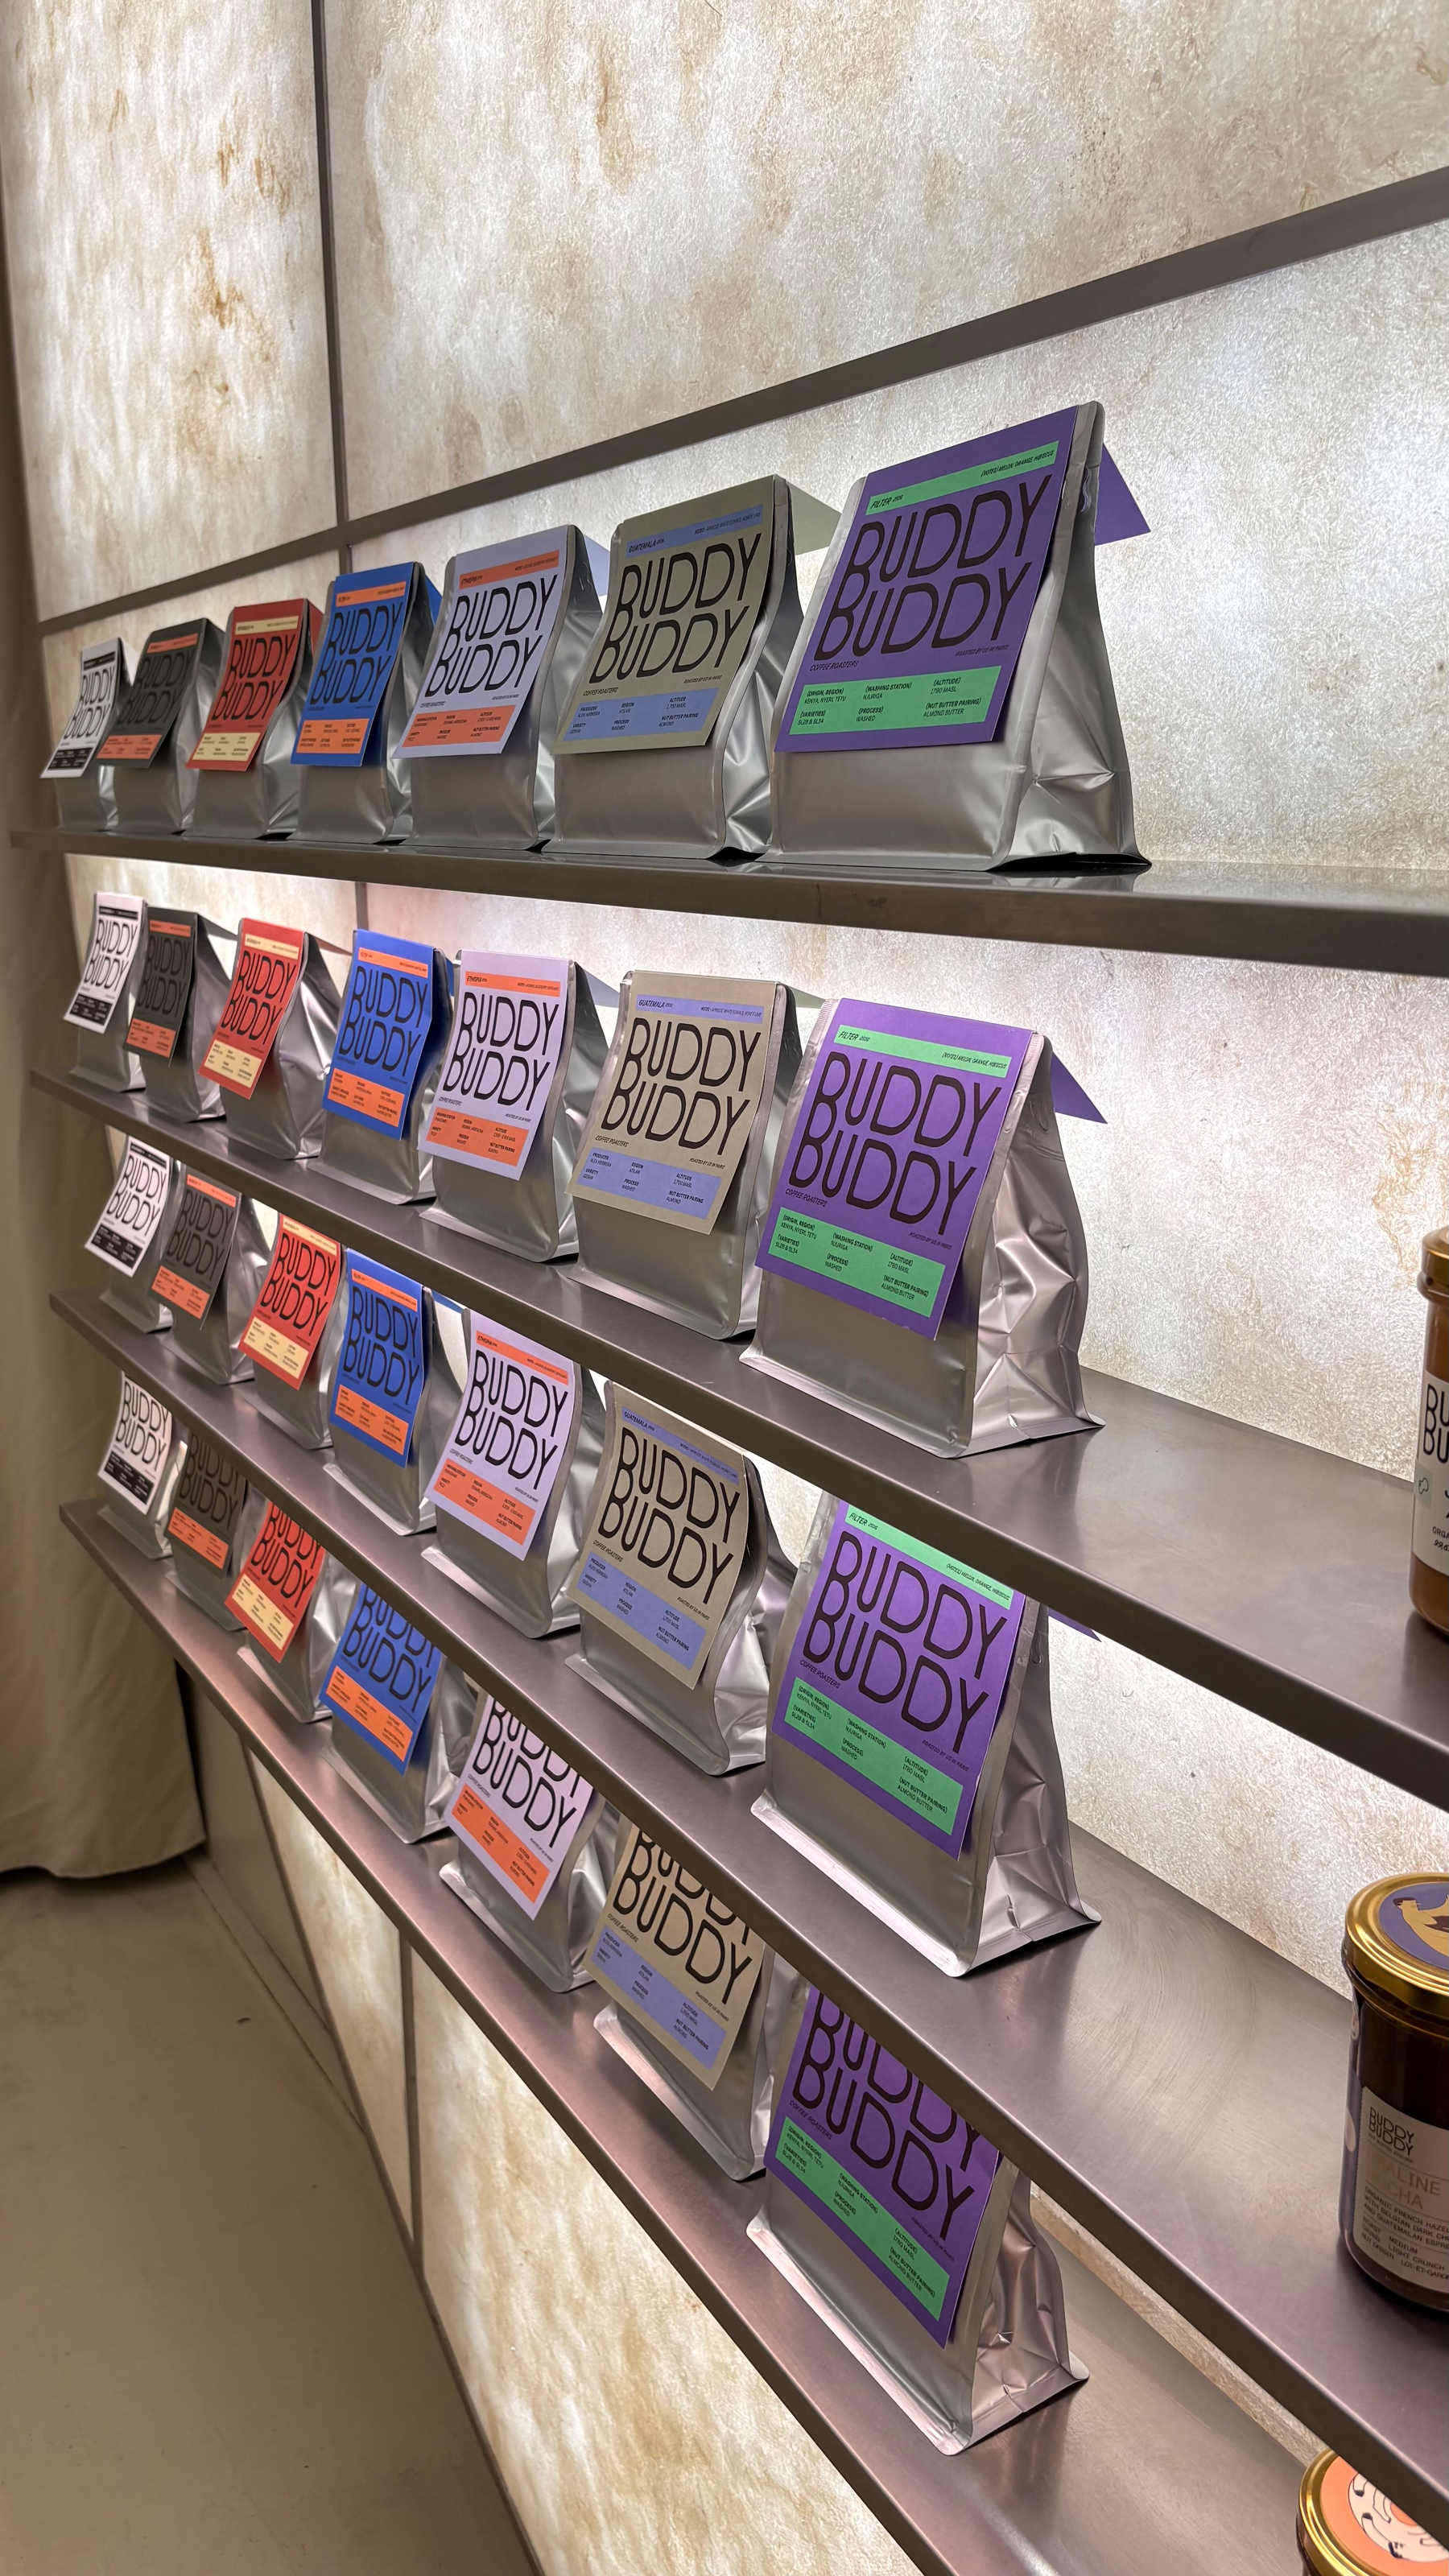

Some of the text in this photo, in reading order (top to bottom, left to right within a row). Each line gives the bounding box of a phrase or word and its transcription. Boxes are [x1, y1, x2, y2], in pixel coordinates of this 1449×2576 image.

[870, 497, 892, 509] FILTER
[840, 474, 1052, 585] BUDDY
[613, 533, 762, 619] BUDDY
[324, 602, 403, 654] BUDDY
[445, 575, 558, 642] BUDDY
[814, 562, 1032, 660] BUDDY
[227, 634, 295, 679] BUDDY
[425, 635, 543, 697] BUDDY
[589, 605, 749, 683] BUDDY
[79, 666, 116, 704] BUDDY
[212, 680, 283, 720] BUDDY
[310, 655, 391, 705] BUDDY
[934, 677, 960, 686] (ALTITUDE)
[939, 700, 957, 708] BUTTER
[957, 698, 981, 707] PAIRING)
[64, 704, 111, 739] BUDDY
[94, 919, 138, 957] BUDDY
[84, 952, 129, 992] BUDDY
[233, 951, 296, 1002] BUDDY
[221, 993, 283, 1045] BUDDY
[350, 966, 427, 1028] BUDDY
[339, 1013, 421, 1076] BUDDY
[458, 992, 559, 1055] BUDDY
[839, 1031, 859, 1041] FILTER
[443, 1042, 551, 1111] BUDDY
[621, 1018, 761, 1092] BUDDY
[601, 1075, 750, 1155] BUDDY
[814, 1051, 1002, 1157] BUDDY
[118, 1155, 167, 1203] BUDDY
[785, 1188, 828, 1208] COFFEE ROASTERS
[789, 1119, 976, 1236] BUDDY
[106, 1187, 160, 1236] BUDDY
[272, 1232, 336, 1296] BUDDY
[825, 1261, 842, 1272] WASHED
[827, 1253, 848, 1266] (PROCESS)
[832, 1232, 873, 1253] (WASHING STATION)
[890, 1253, 913, 1267] (ALTITUDE)
[881, 1283, 914, 1300] ALMOND BUTTER
[884, 1274, 929, 1298] (NUT BUTTER PAIRING)
[898, 1265, 910, 1274] MASL
[261, 1274, 328, 1336] BUDDY
[349, 1286, 418, 1357] BUDDY
[343, 1334, 419, 1406] BUDDY
[469, 1349, 568, 1437] BUDDY
[115, 1412, 167, 1472] BUDDY
[454, 1401, 558, 1490] BUDDY
[615, 1426, 740, 1543] BUDDY
[849, 1513, 868, 1526] FILTER
[598, 1485, 733, 1604] BUDDY
[250, 1532, 314, 1608] BUDDY
[824, 1531, 1008, 1680] BUDDY
[342, 1616, 431, 1713] BUDDY
[800, 1659, 840, 1689] COFFEE ROASTERS
[803, 1600, 989, 1753] BUDDY
[841, 1745, 858, 1760] WASHED
[842, 1737, 864, 1757] (PROCESS)
[847, 1718, 886, 1748] (WASHING STATION)
[473, 1730, 576, 1847] BUDDY
[904, 1756, 929, 1776] (ALTITUDE)
[913, 1770, 925, 1783] MASL
[898, 1785, 933, 1811] ALMOND BUTTER
[899, 1776, 948, 1813] (NUT BUTTER PAIRING)
[613, 1860, 752, 2004] BUDDY
[789, 2100, 833, 2140] COFFEE ROASTERS
[793, 2047, 976, 2241] BUDDY
[1368, 2118, 1414, 2156] BUDDY
[1370, 2106, 1414, 2143] BUDDY
[1377, 2213, 1423, 2242] GUATEMALAN
[1381, 2207, 1410, 2228] BELGIAN
[1413, 2225, 1433, 2237] DARK
[1394, 2207, 1423, 2225] FRENCH
[1388, 2244, 1410, 2259] LIGHT
[1412, 2256, 1446, 2271] CRUNCH
[1389, 2236, 1418, 2254] MEDIUM
